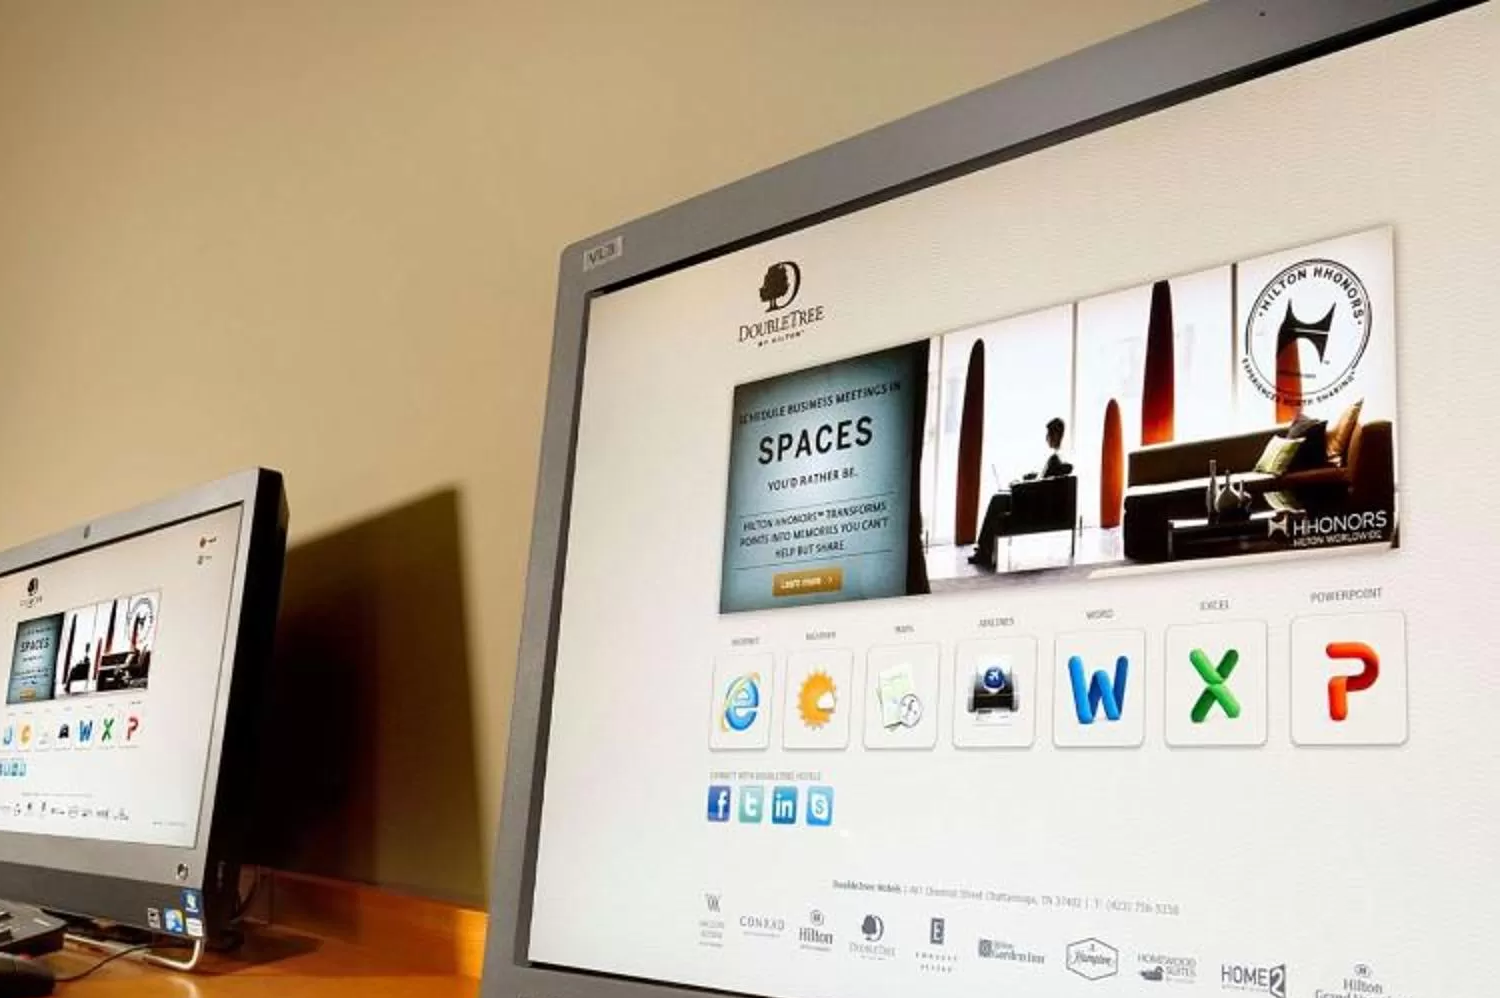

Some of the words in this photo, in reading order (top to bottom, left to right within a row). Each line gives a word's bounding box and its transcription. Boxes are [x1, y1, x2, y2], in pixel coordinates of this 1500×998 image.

[1260, 267, 1307, 312] HILTON
[1313, 266, 1365, 319] HHONORS
[739, 405, 785, 424] SCHEDULE
[787, 394, 833, 415] BUSINESS
[835, 383, 887, 404] MEETINGS
[888, 381, 901, 393] IN
[758, 415, 873, 465] SPACES
[767, 474, 798, 491] YOU'D
[800, 470, 839, 486] RATHER
[743, 519, 773, 532] HILTON
[825, 501, 886, 518] TRANSFORMS
[1293, 510, 1387, 536] HHONORS
[739, 534, 769, 548] POINTS
[770, 530, 791, 543] INTO
[793, 524, 839, 540] MEMORIES
[840, 521, 860, 534] YOU
[861, 517, 889, 531] CAN'T
[775, 547, 794, 559] HELP
[797, 544, 814, 556] BUT
[815, 540, 845, 553] SHARE
[1310, 587, 1384, 604] POWERPOINT
[1067, 655, 1129, 724] W
[1189, 648, 1241, 724] X
[775, 793, 793, 818] in
[740, 915, 785, 930] CONRAD
[799, 927, 833, 945] Hilton
[1343, 978, 1383, 994] Hilton
